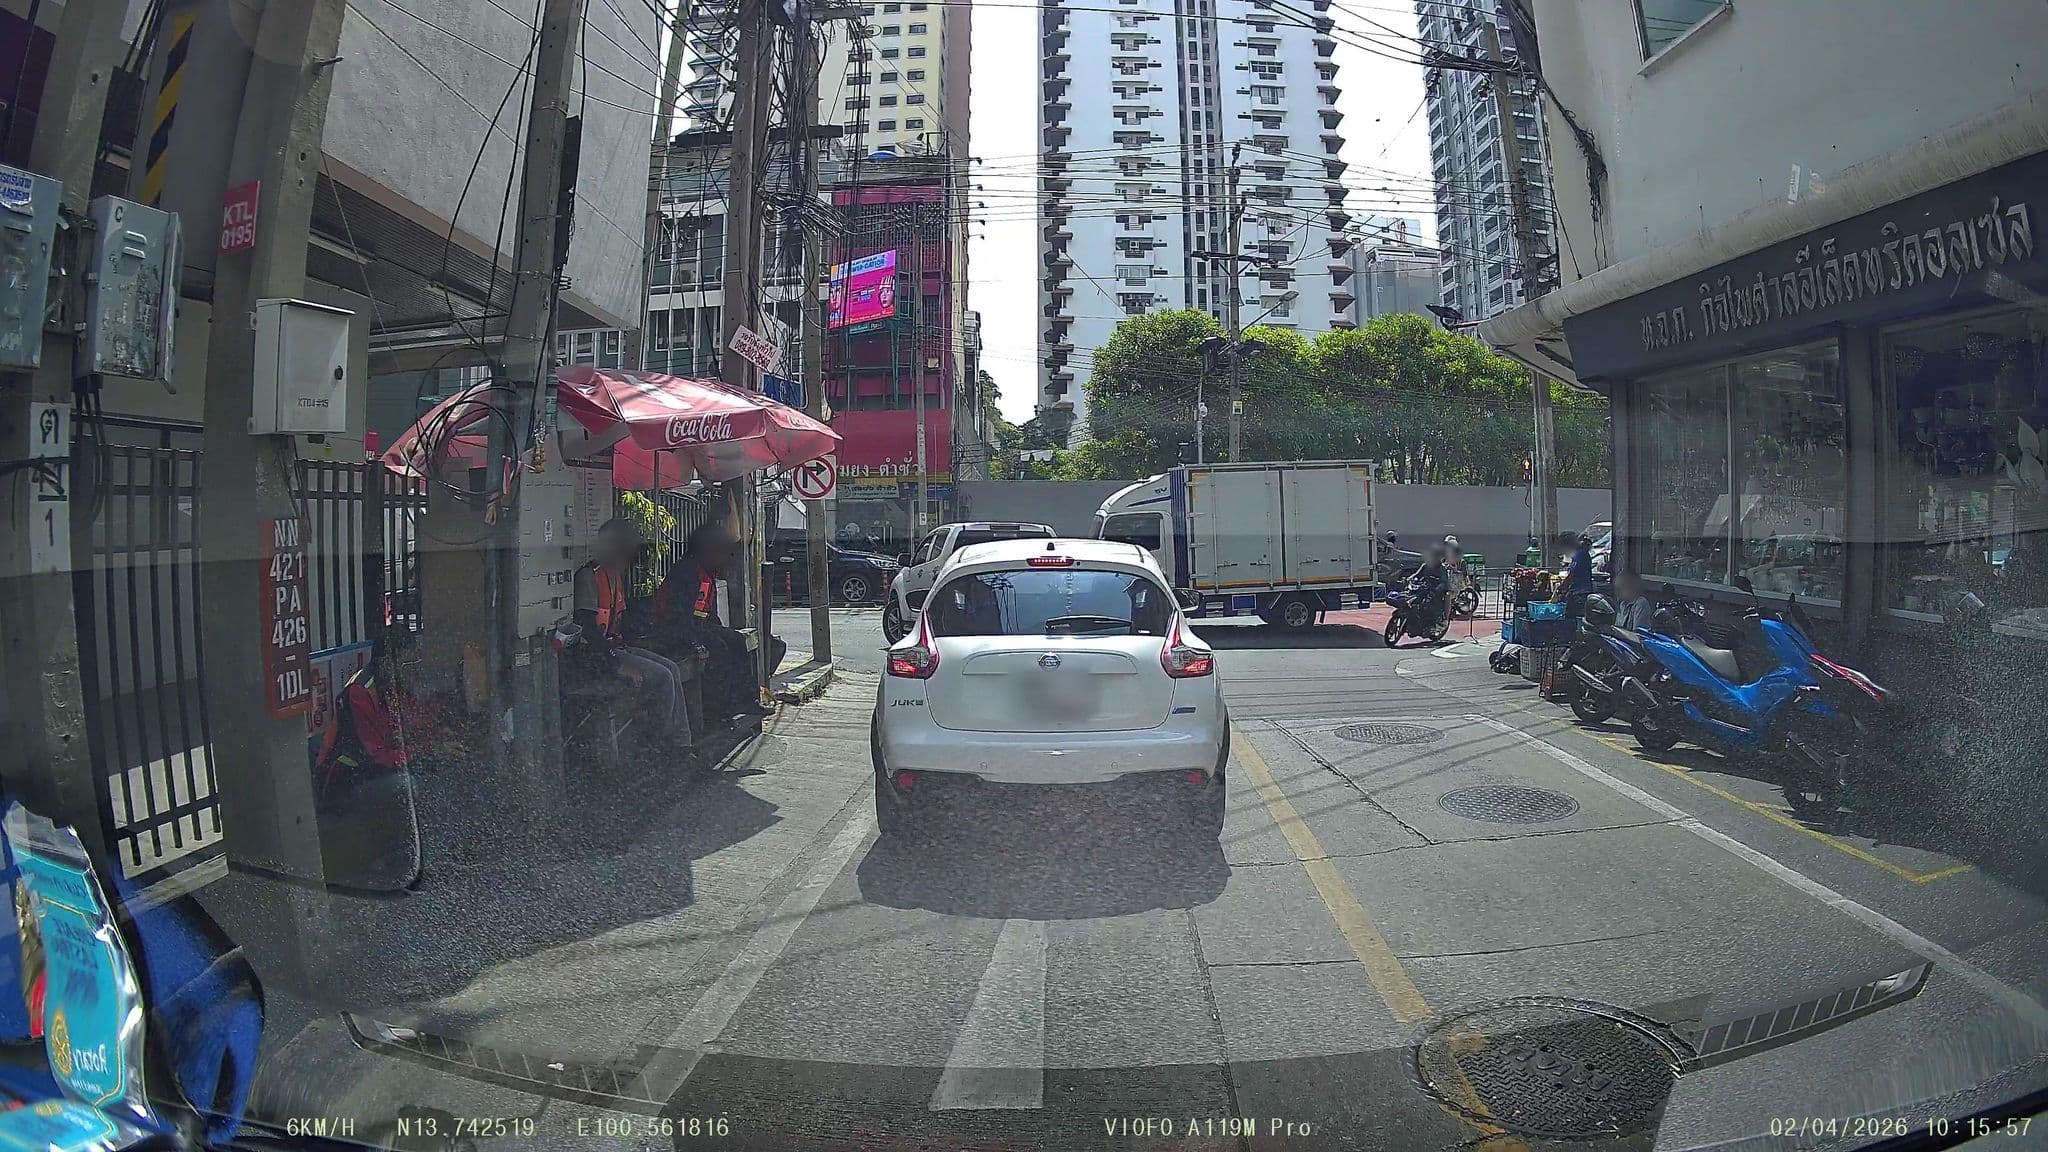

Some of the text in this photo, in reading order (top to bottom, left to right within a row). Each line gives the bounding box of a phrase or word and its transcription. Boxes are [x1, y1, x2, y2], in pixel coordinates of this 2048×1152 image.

[222, 201, 253, 227] KTL
[221, 222, 253, 249] 0195
[274, 519, 299, 547] NN
[270, 551, 304, 582] 421
[275, 585, 302, 615] PA
[272, 616, 306, 649] 426
[277, 668, 309, 701] 1DL
[890, 699, 923, 707] JUKE
